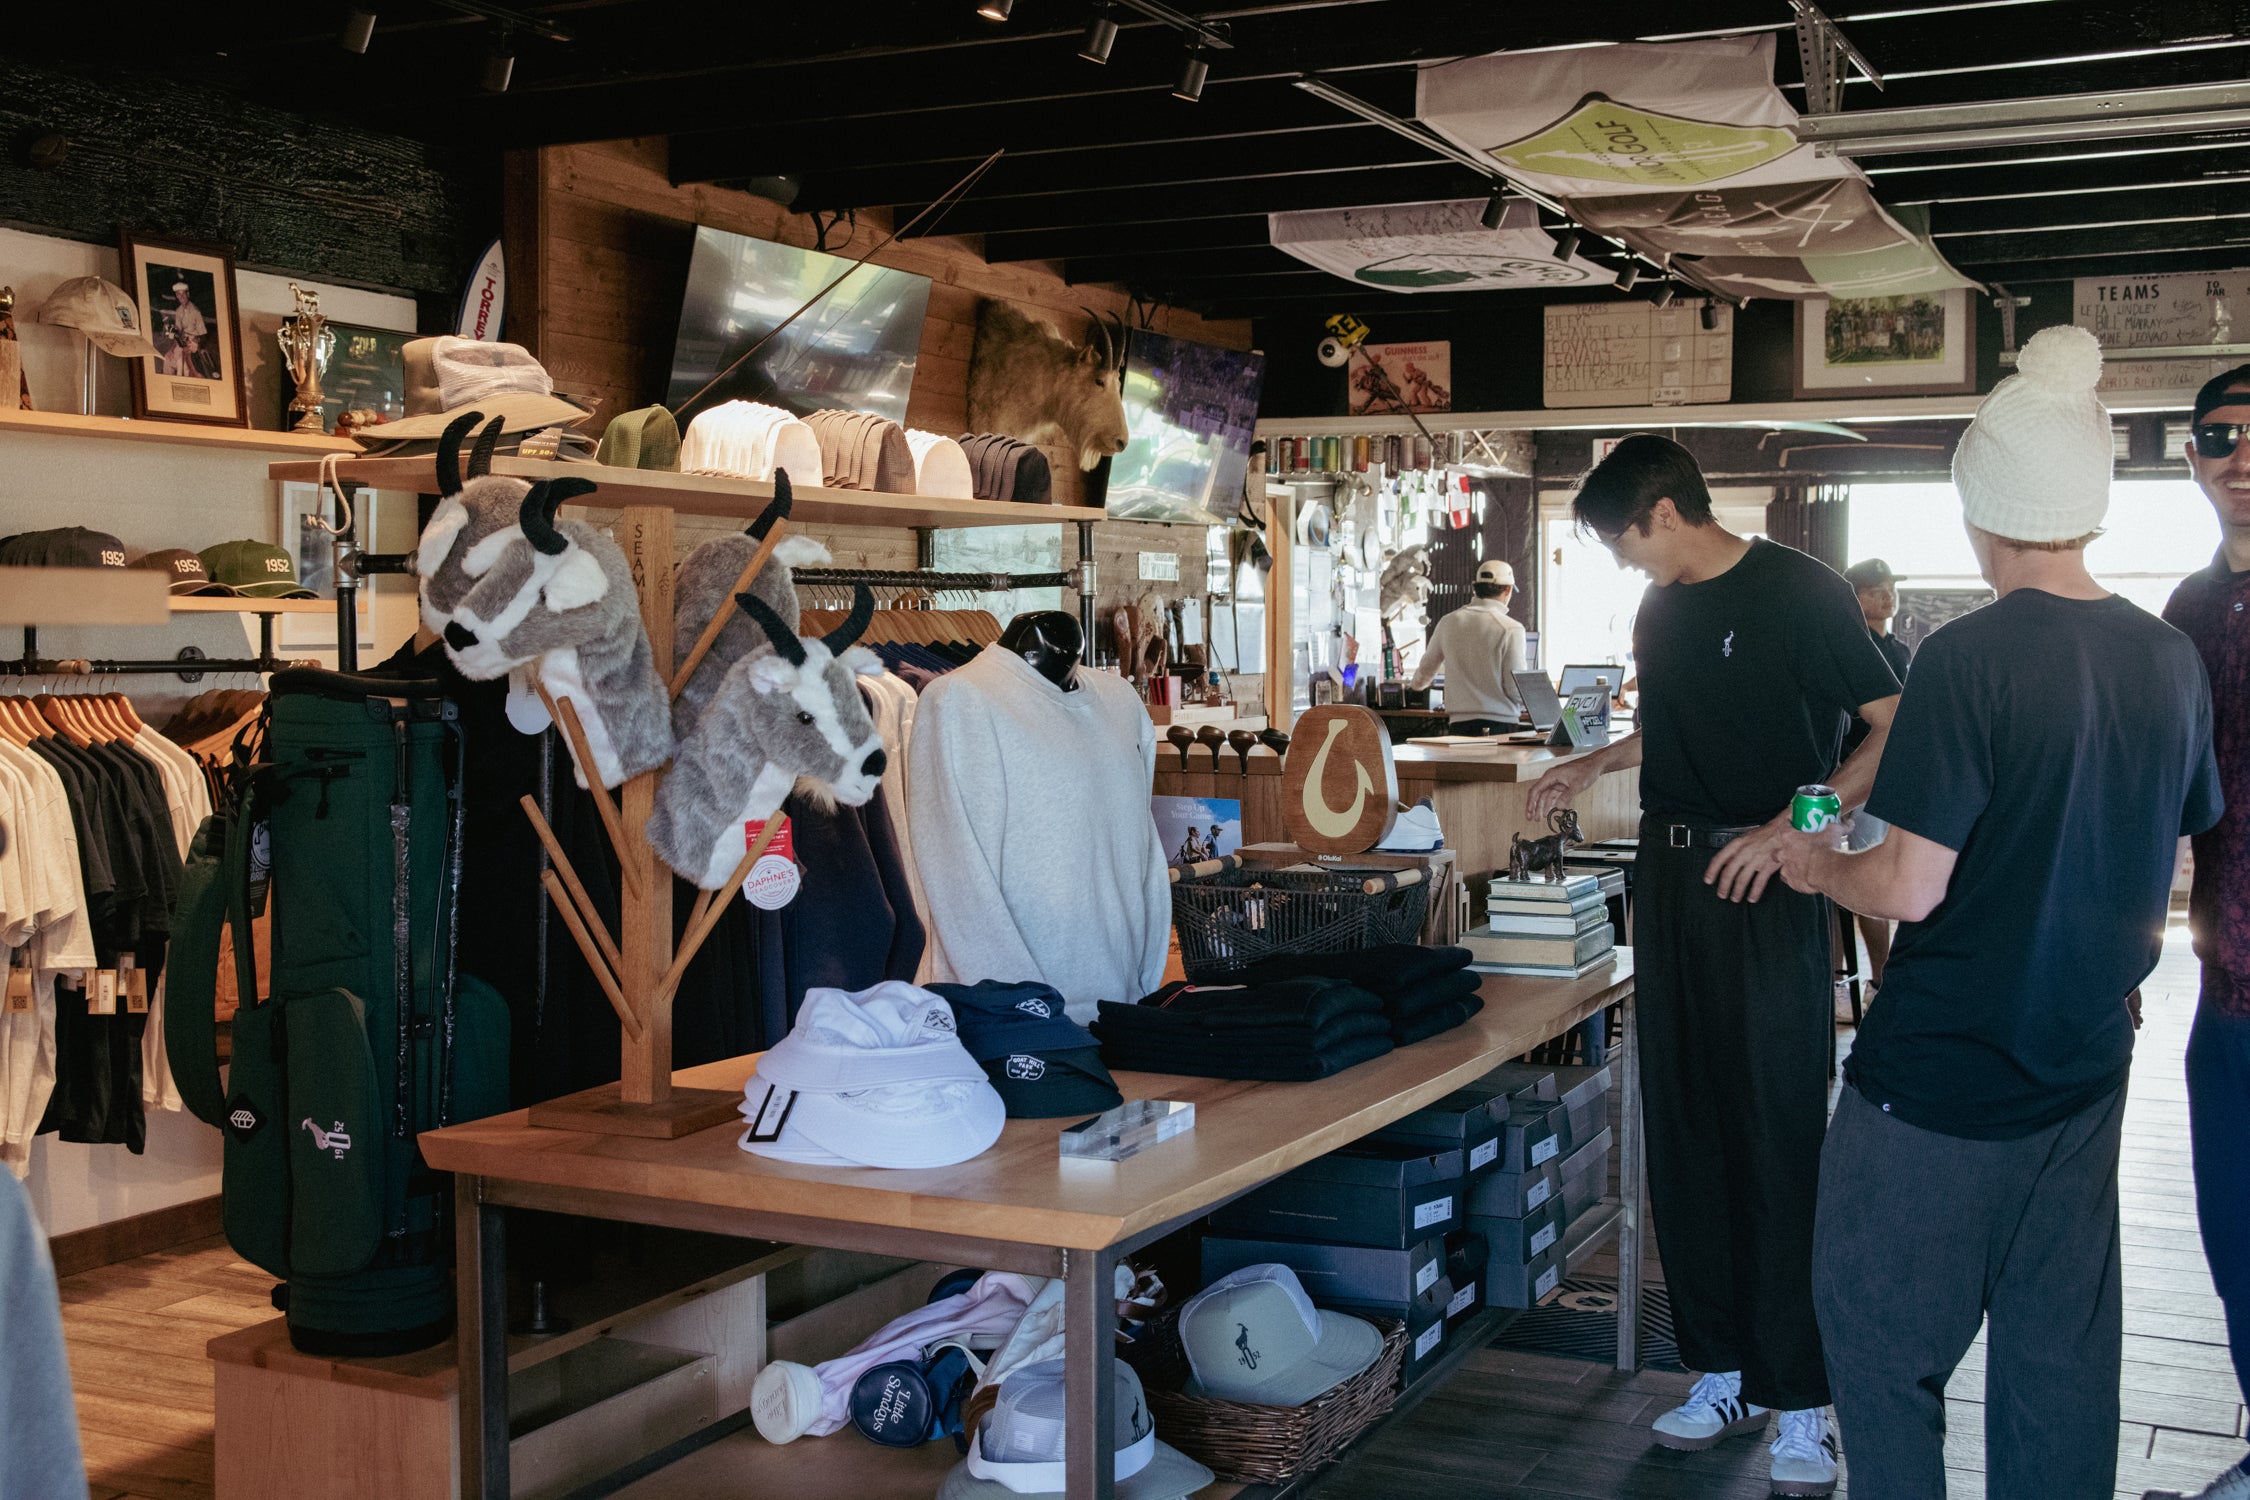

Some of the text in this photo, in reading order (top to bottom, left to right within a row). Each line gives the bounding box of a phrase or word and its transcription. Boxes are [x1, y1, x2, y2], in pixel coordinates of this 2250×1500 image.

[1595, 120, 1648, 154] GOLF
[2098, 284, 2160, 301] TEAMS
[2206, 288, 2225, 297] PAR
[1384, 346, 1428, 356] GUINNESS
[101, 550, 125, 567] 1952
[174, 558, 202, 573] 1952
[264, 558, 290, 573] 1952
[747, 868, 795, 890] DAPHNE'S
[1018, 1062, 1034, 1070] PARK
[872, 1374, 901, 1433] Sundays
[891, 1390, 911, 1424] Little
